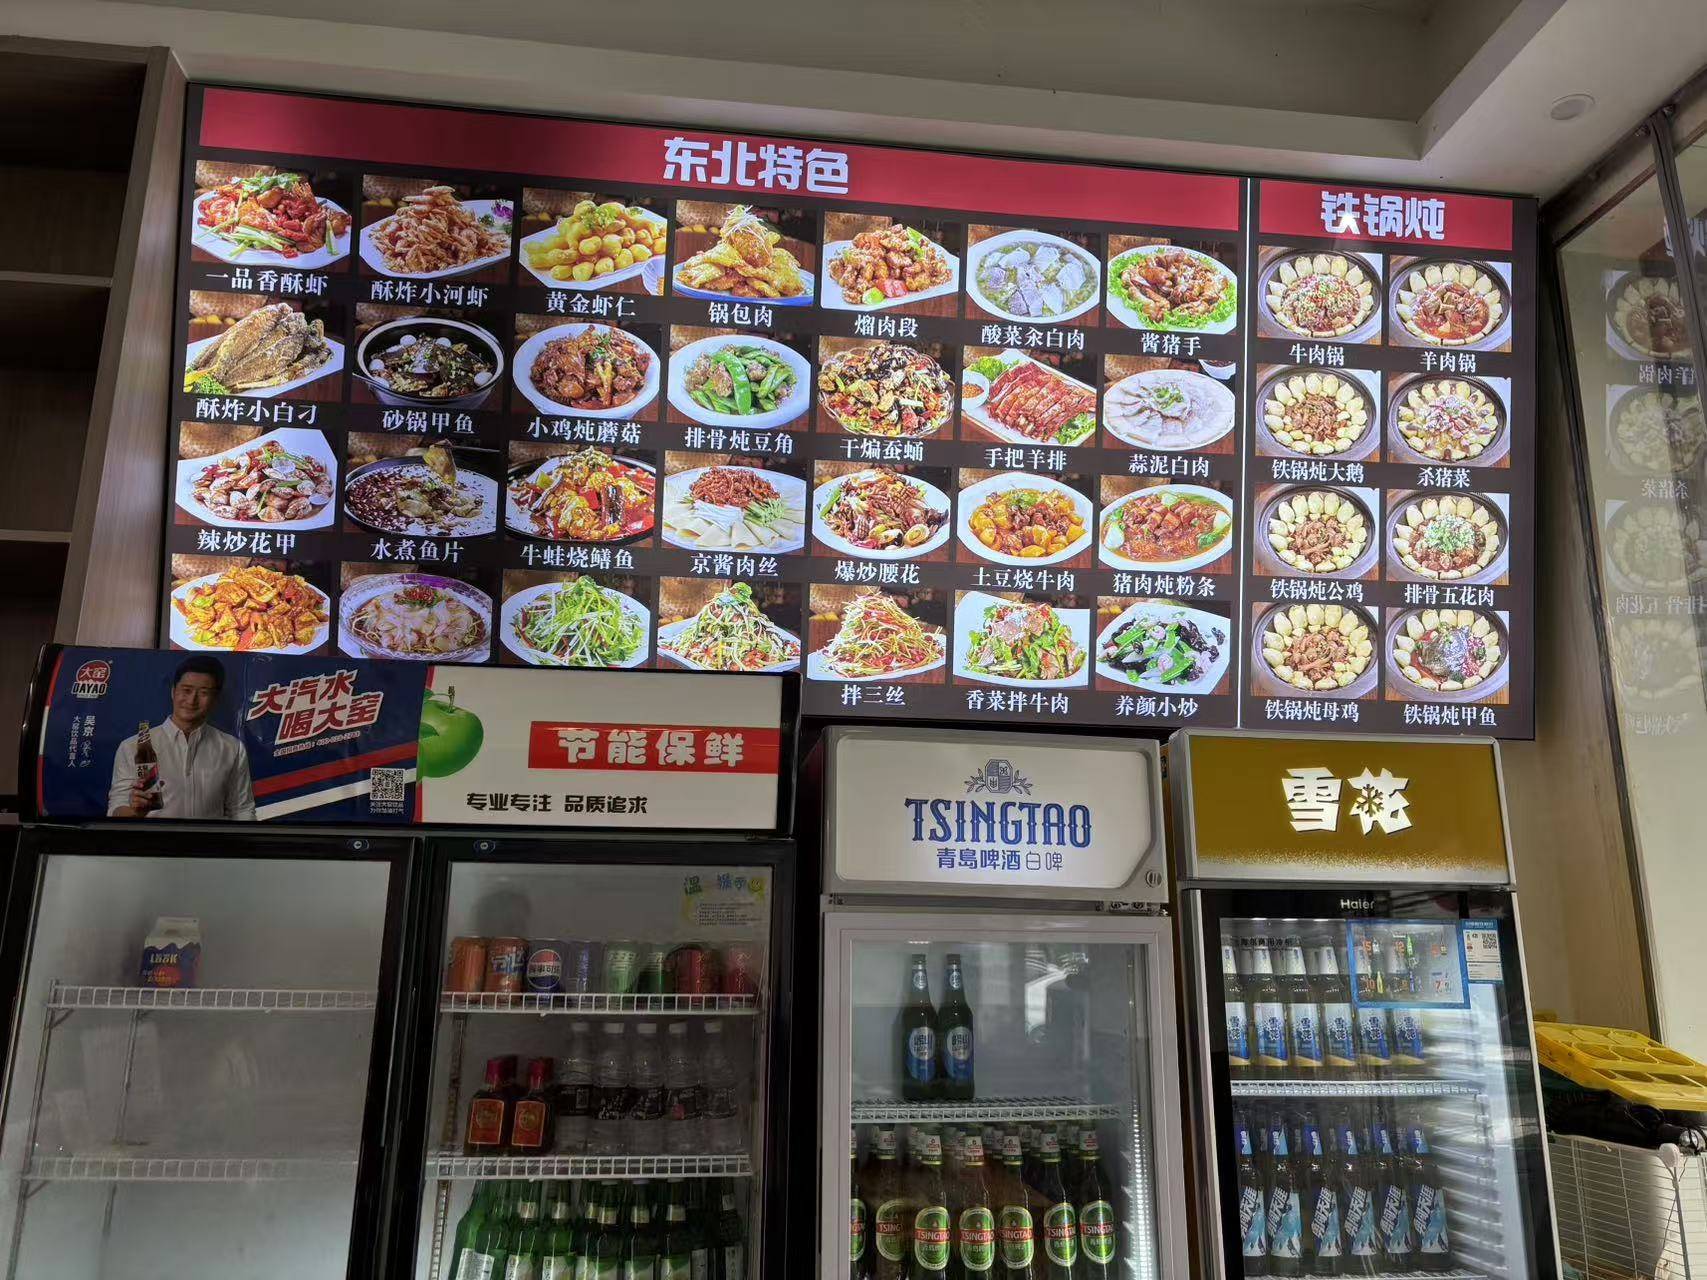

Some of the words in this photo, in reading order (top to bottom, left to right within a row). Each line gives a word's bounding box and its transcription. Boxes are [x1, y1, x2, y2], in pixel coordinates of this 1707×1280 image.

[663, 136, 848, 194] 东北特色
[1320, 191, 1445, 241] 铁锅炖
[206, 267, 328, 297] 一品香酥虾
[370, 280, 489, 309] 酥炸小河虾
[545, 292, 636, 317] 黄金虾仁
[708, 302, 773, 327] 锅包肉
[854, 314, 918, 338] 熘肉段
[1141, 333, 1202, 356] 酱猪手
[1289, 344, 1345, 366] 牛肉锅
[1421, 351, 1477, 374] 羊肉锅
[195, 398, 318, 424] 酥炸小白刁
[382, 410, 475, 433] 砂锅甲鱼
[527, 416, 641, 444] 小鸡炖蘑菇
[684, 427, 794, 455] 排骨炖豆角
[840, 438, 924, 461] 干煸蚕蛹
[983, 448, 1068, 470] 手把羊排
[1128, 454, 1210, 477] 蒜泥白肉
[1272, 459, 1364, 483] 铁锅炖大鹅
[1417, 466, 1471, 488] 杀猪菜
[197, 529, 296, 554] 辣炒花甲
[370, 538, 464, 563] 水煮鱼片
[520, 544, 634, 570] 牛蛙烧鳝鱼
[690, 553, 778, 577] 京酱肉丝
[834, 560, 920, 584] 爆炒腰花
[973, 569, 1075, 592] 土豆烧牛肉
[1113, 573, 1216, 597] 猪肉炖粉条
[1270, 579, 1364, 603] 铁锅炖公鸡
[1404, 585, 1495, 607] 排骨五花肉
[72, 682, 107, 695] DAYAO
[248, 671, 356, 719] 大汽水
[841, 684, 906, 706] 拌三丝
[966, 689, 1069, 714] 香菜拌牛肉
[1115, 695, 1199, 718] 养颜小炒
[1265, 700, 1360, 724] 铁锅炖母鸡
[277, 692, 383, 743] 喝大窑
[1404, 704, 1497, 728] 铁锅炖甲鱼
[558, 729, 744, 768] 节能保鲜
[466, 792, 552, 813] 专业专注
[564, 794, 648, 815] 品质追求
[1281, 767, 1413, 835] 雪花
[904, 798, 1092, 848] TSINGTAO
[936, 848, 1021, 870] 青島啤酒
[1025, 852, 1063, 871] 白啤
[1340, 898, 1376, 910] Haier
